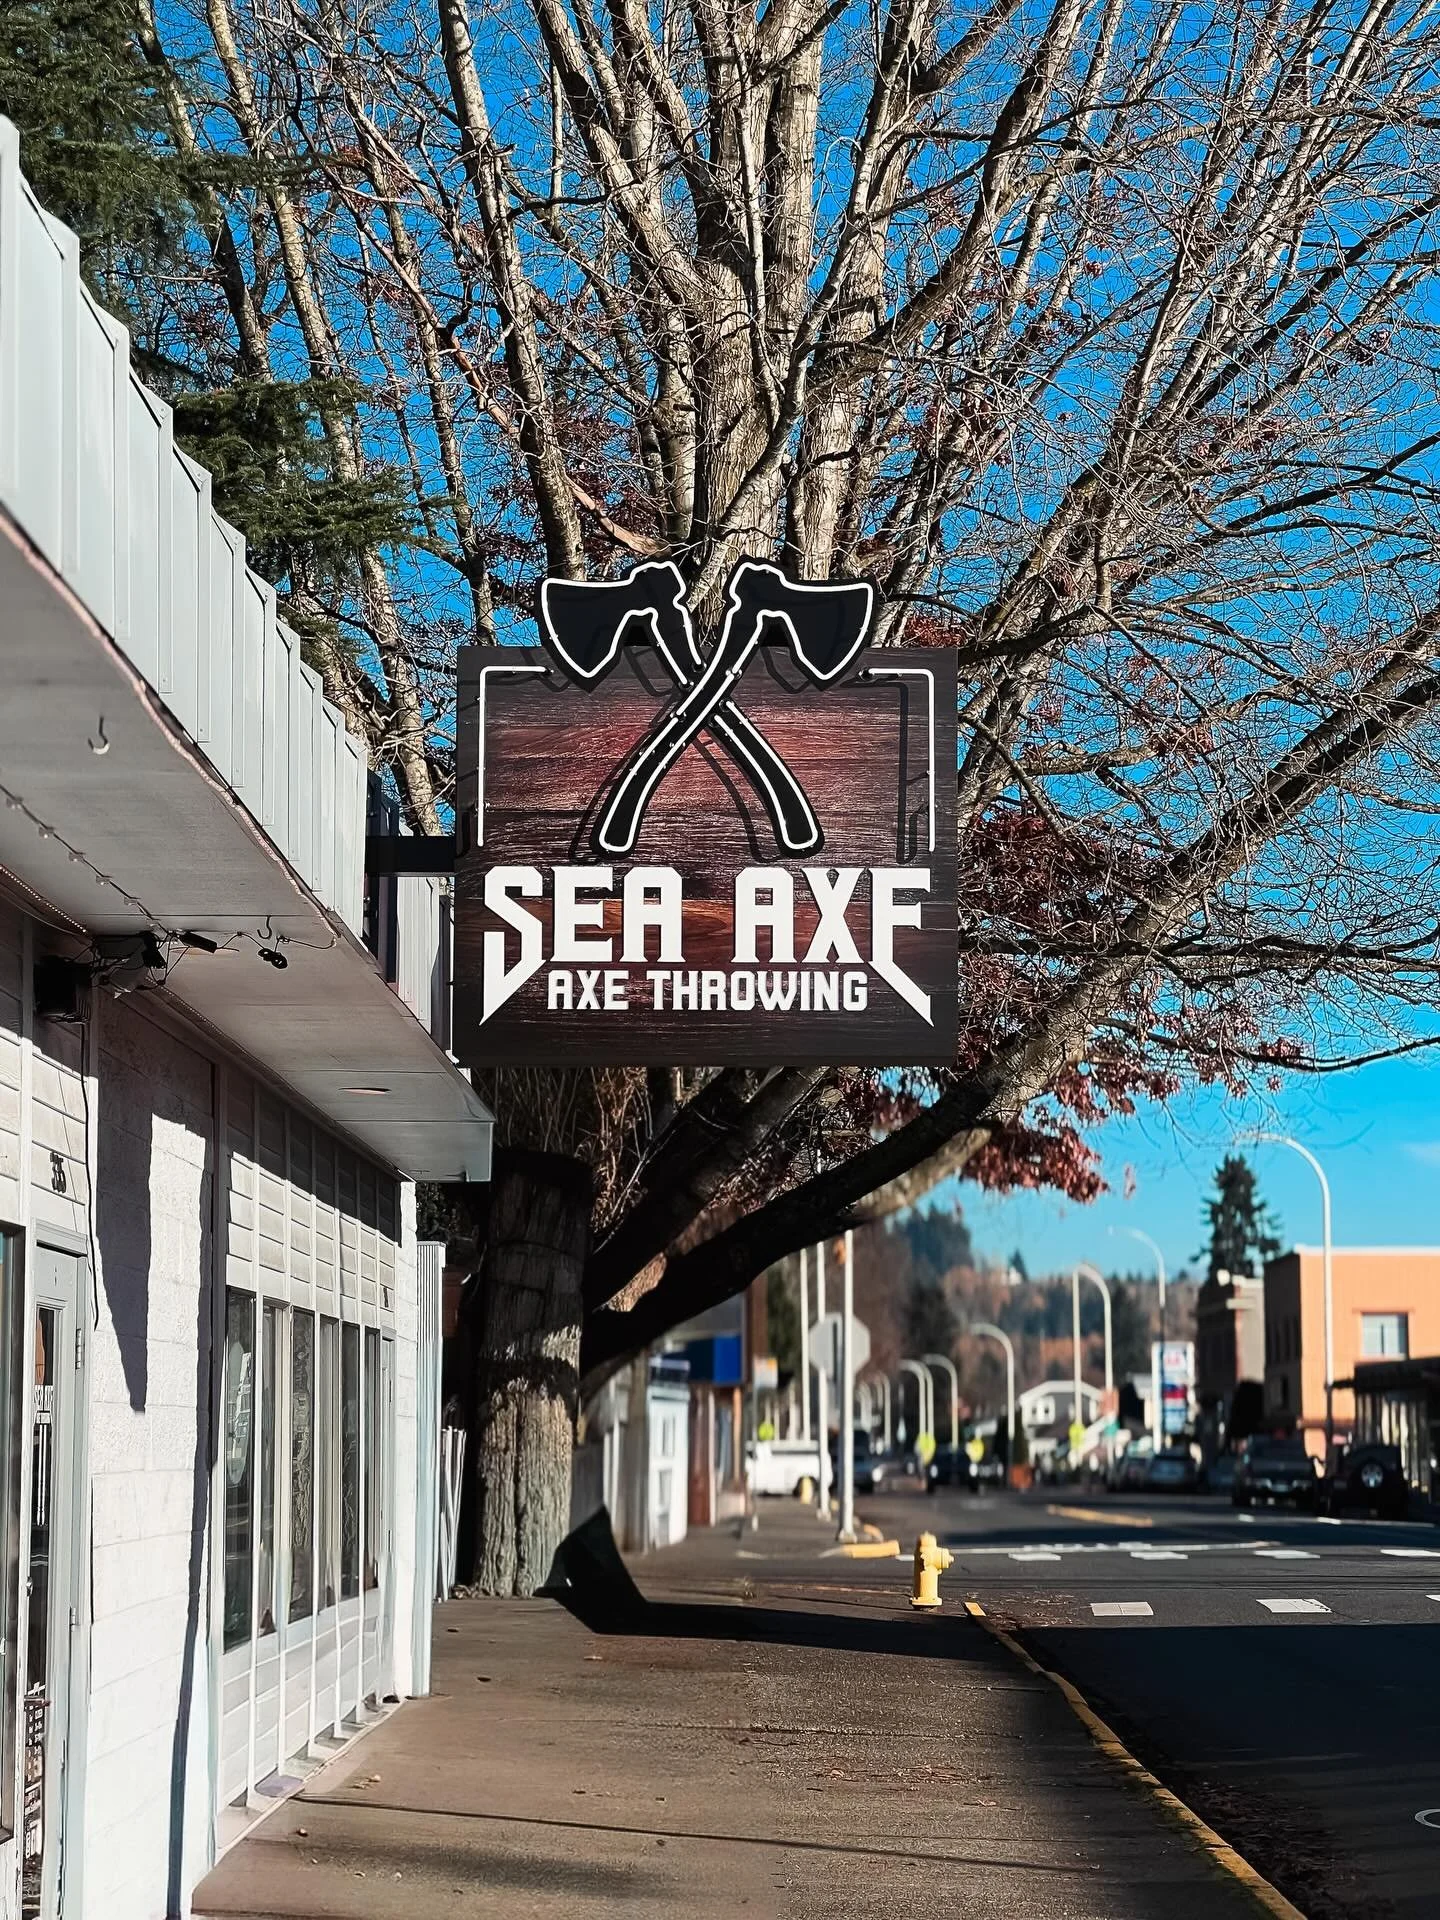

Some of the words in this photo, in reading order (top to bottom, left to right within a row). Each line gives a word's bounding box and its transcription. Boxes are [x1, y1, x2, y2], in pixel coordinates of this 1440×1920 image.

[478, 865, 687, 1026] SEA
[730, 865, 935, 1028] AXE
[547, 969, 629, 1011] AXE
[646, 969, 868, 1012] THROWING
